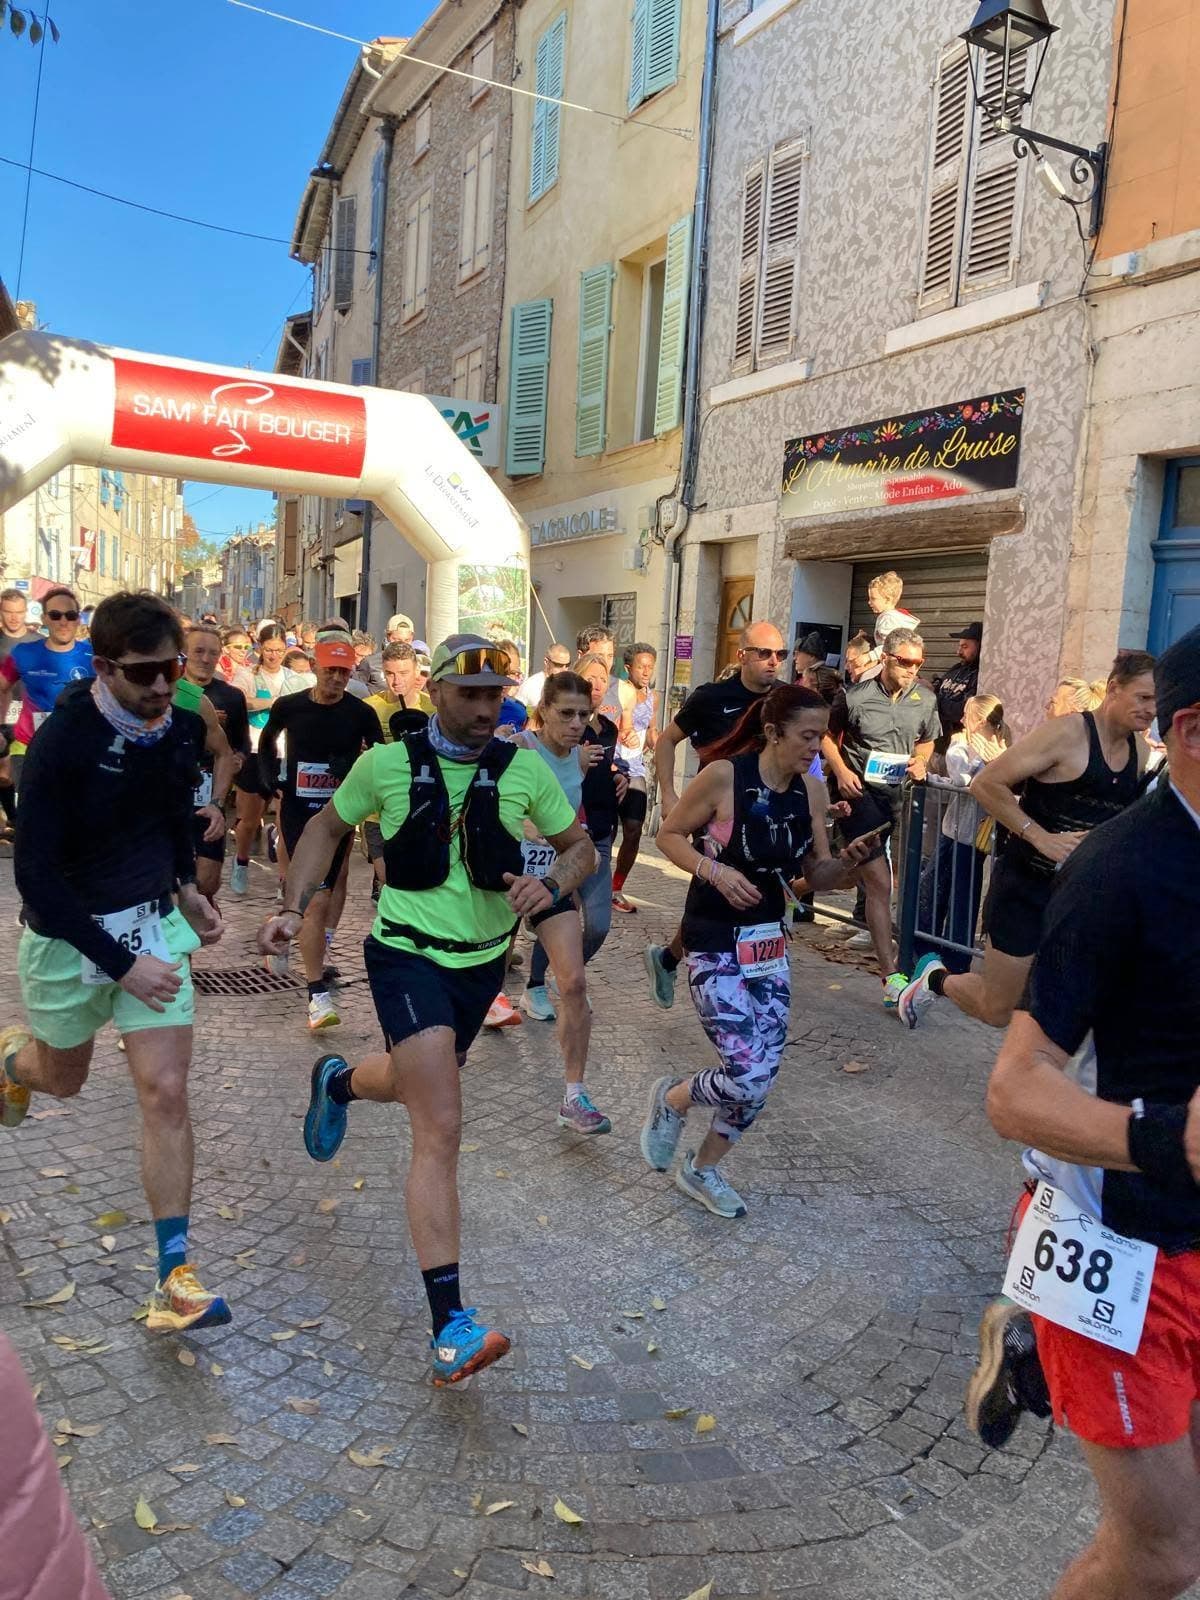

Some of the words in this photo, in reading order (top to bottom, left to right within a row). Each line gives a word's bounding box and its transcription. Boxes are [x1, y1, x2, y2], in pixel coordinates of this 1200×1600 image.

[202, 402, 251, 430] FAIT
[258, 411, 351, 445] BOUGER
[783, 452, 900, 494] L'Armoire
[903, 443, 930, 471] de
[934, 425, 1017, 468] Louise
[844, 493, 868, 506] Vente
[874, 488, 901, 500] Mode
[902, 482, 935, 498] Enfant
[942, 479, 963, 492] Ado
[880, 471, 926, 487] Responsable
[527, 849, 555, 866] 227
[1034, 1229, 1113, 1294] 638
